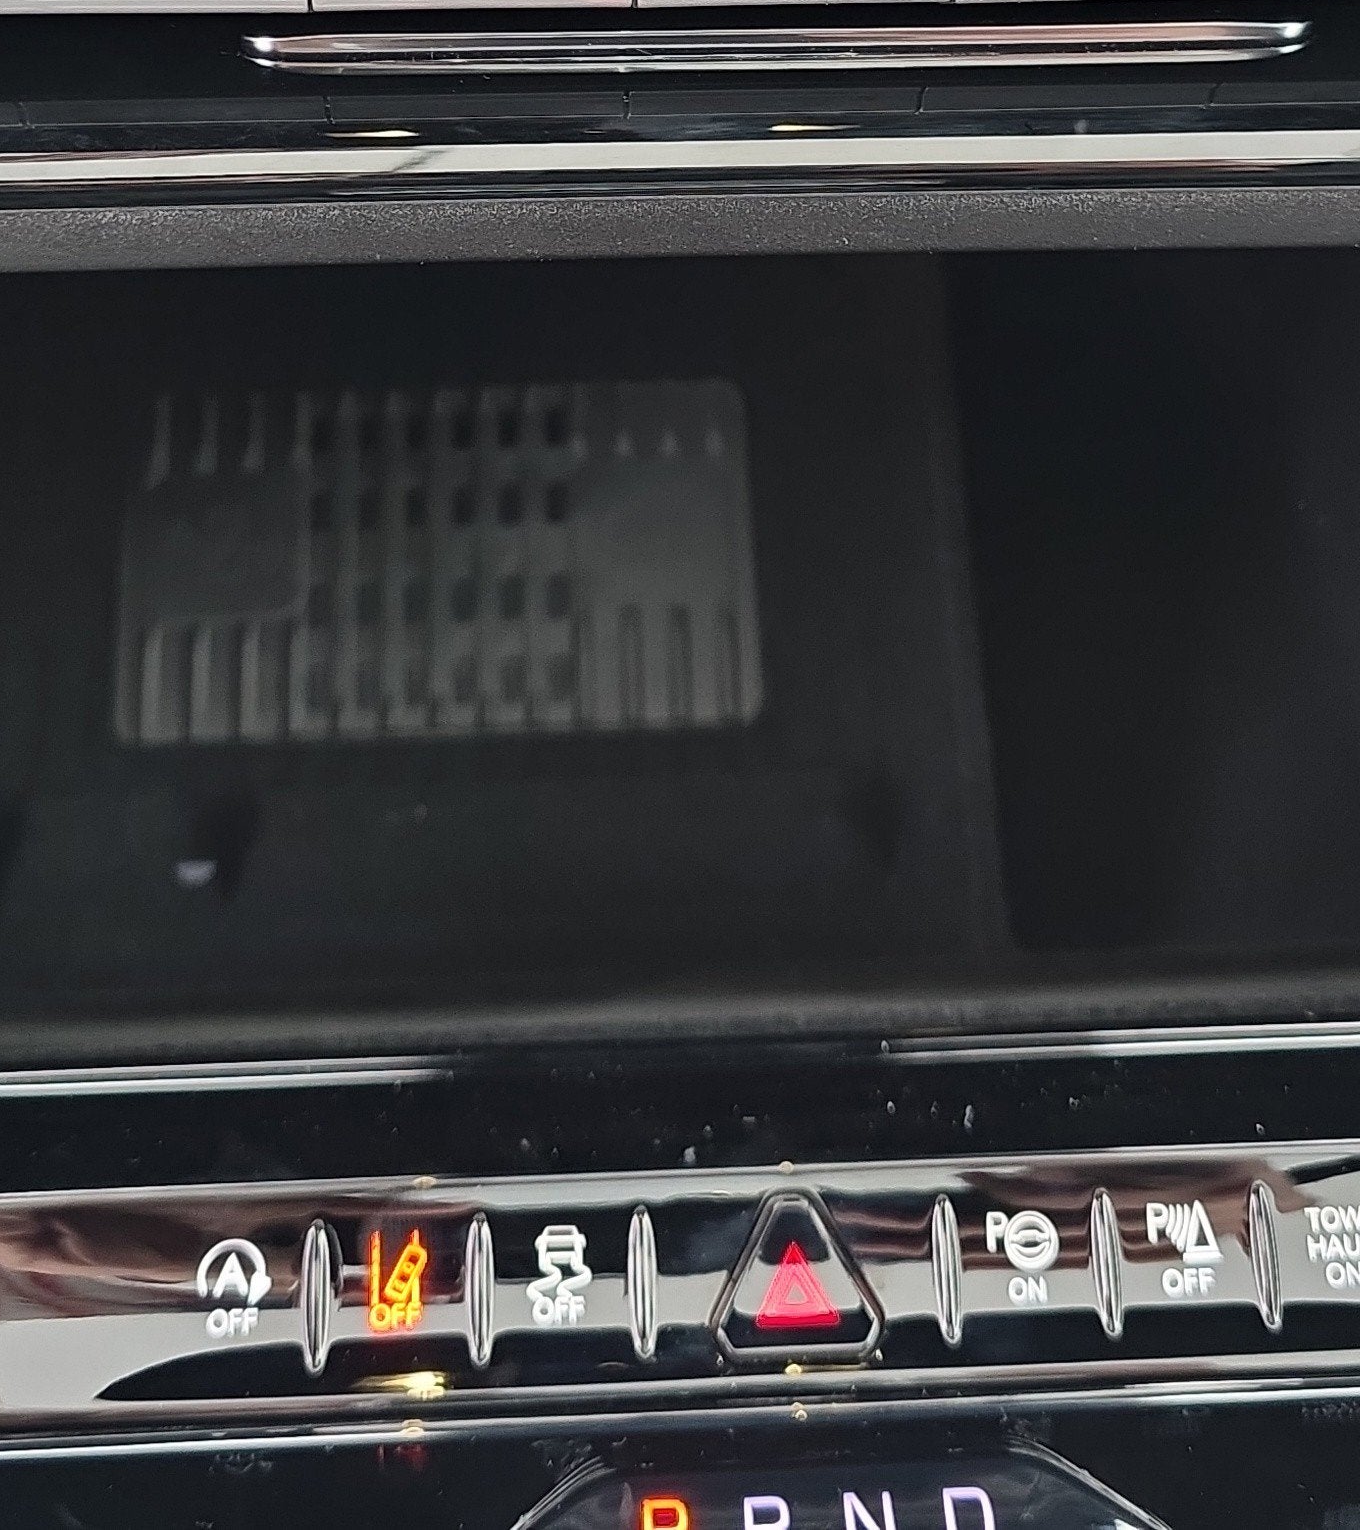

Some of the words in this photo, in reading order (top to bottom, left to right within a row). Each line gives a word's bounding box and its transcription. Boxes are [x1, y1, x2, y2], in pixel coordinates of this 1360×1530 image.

[1007, 1275, 1048, 1306] ON
[1161, 1267, 1217, 1298] OFF
[206, 1307, 259, 1338] OFF
[369, 1302, 422, 1332] OFF
[532, 1296, 586, 1326] OFF
[842, 1491, 896, 1530] N
[942, 1486, 996, 1530] D
